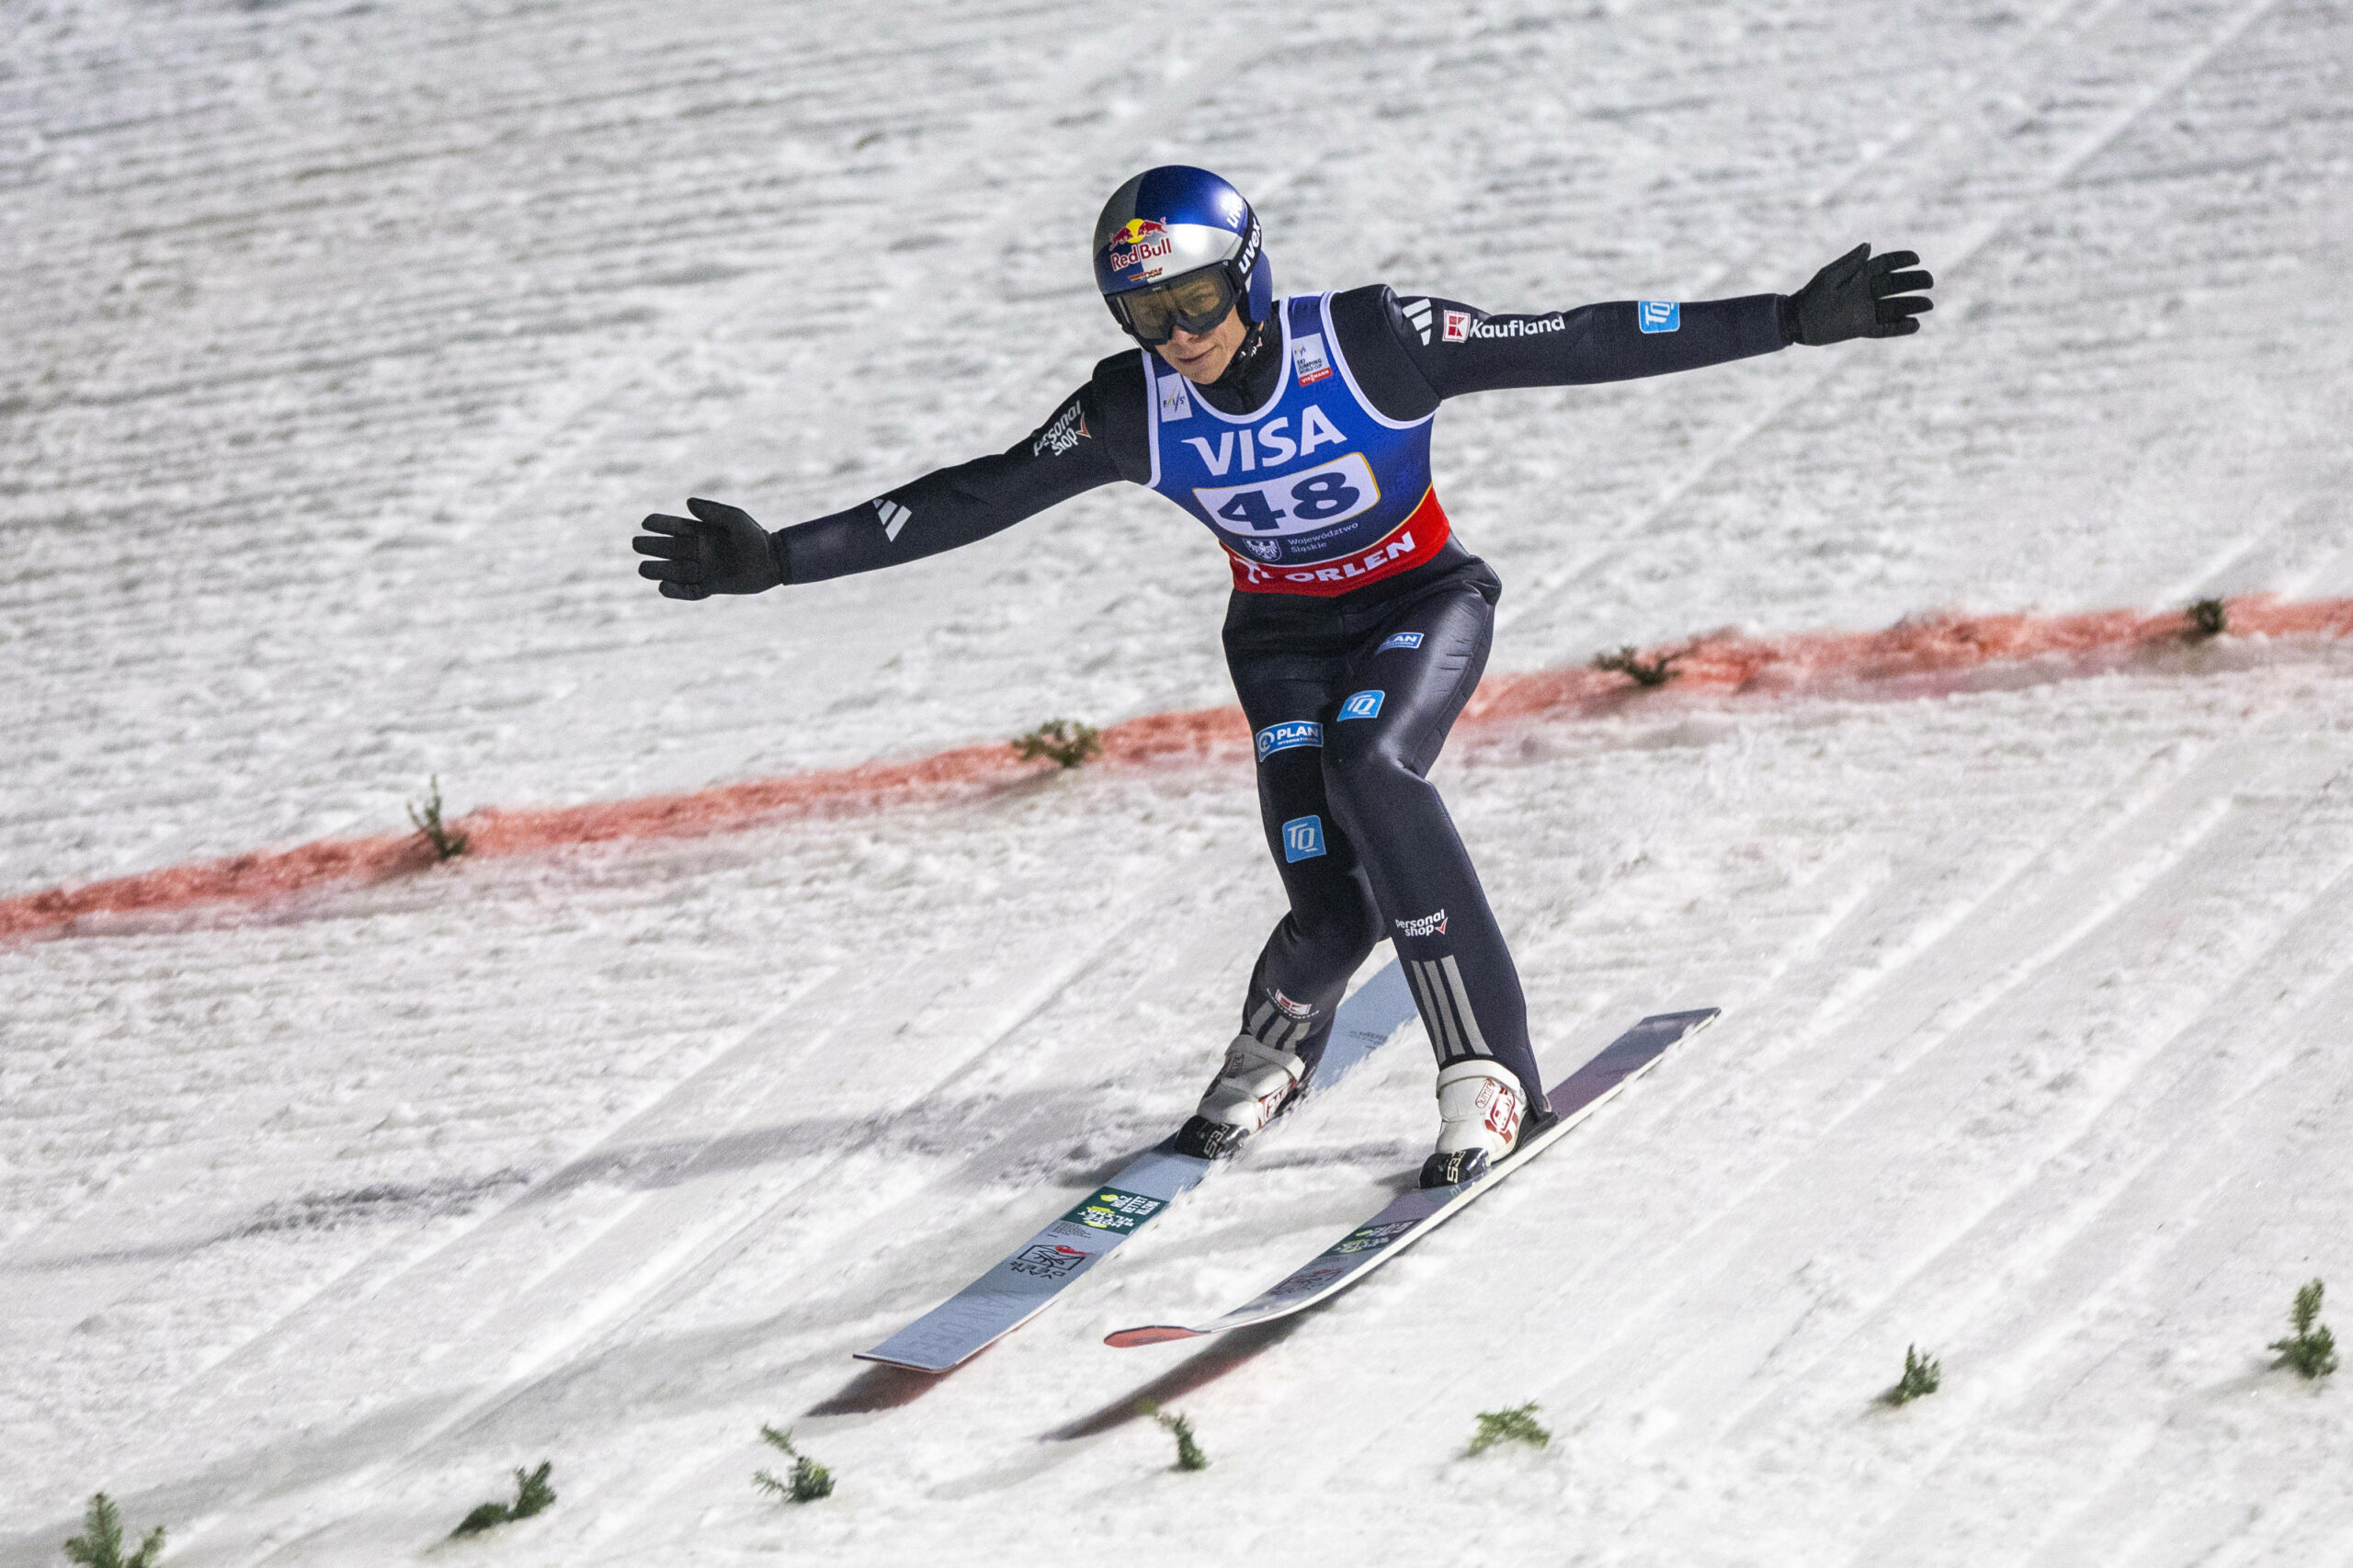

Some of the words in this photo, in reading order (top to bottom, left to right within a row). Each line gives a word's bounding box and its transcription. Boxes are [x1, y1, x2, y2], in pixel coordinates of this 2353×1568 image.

[1109, 248, 1139, 271] Red
[1139, 237, 1173, 261] Bull
[1238, 216, 1261, 275] uvex
[1470, 315, 1565, 339] Kaufland
[1181, 404, 1347, 476] VISA
[1217, 472, 1360, 530] 48
[1288, 522, 1358, 545] Województwo
[1285, 530, 1416, 582] ORLEN
[1347, 694, 1376, 715] TQ
[1277, 725, 1319, 740] PLAN
[1288, 823, 1318, 853] TQ
[1395, 908, 1445, 928] personal
[1404, 925, 1434, 937] shop
